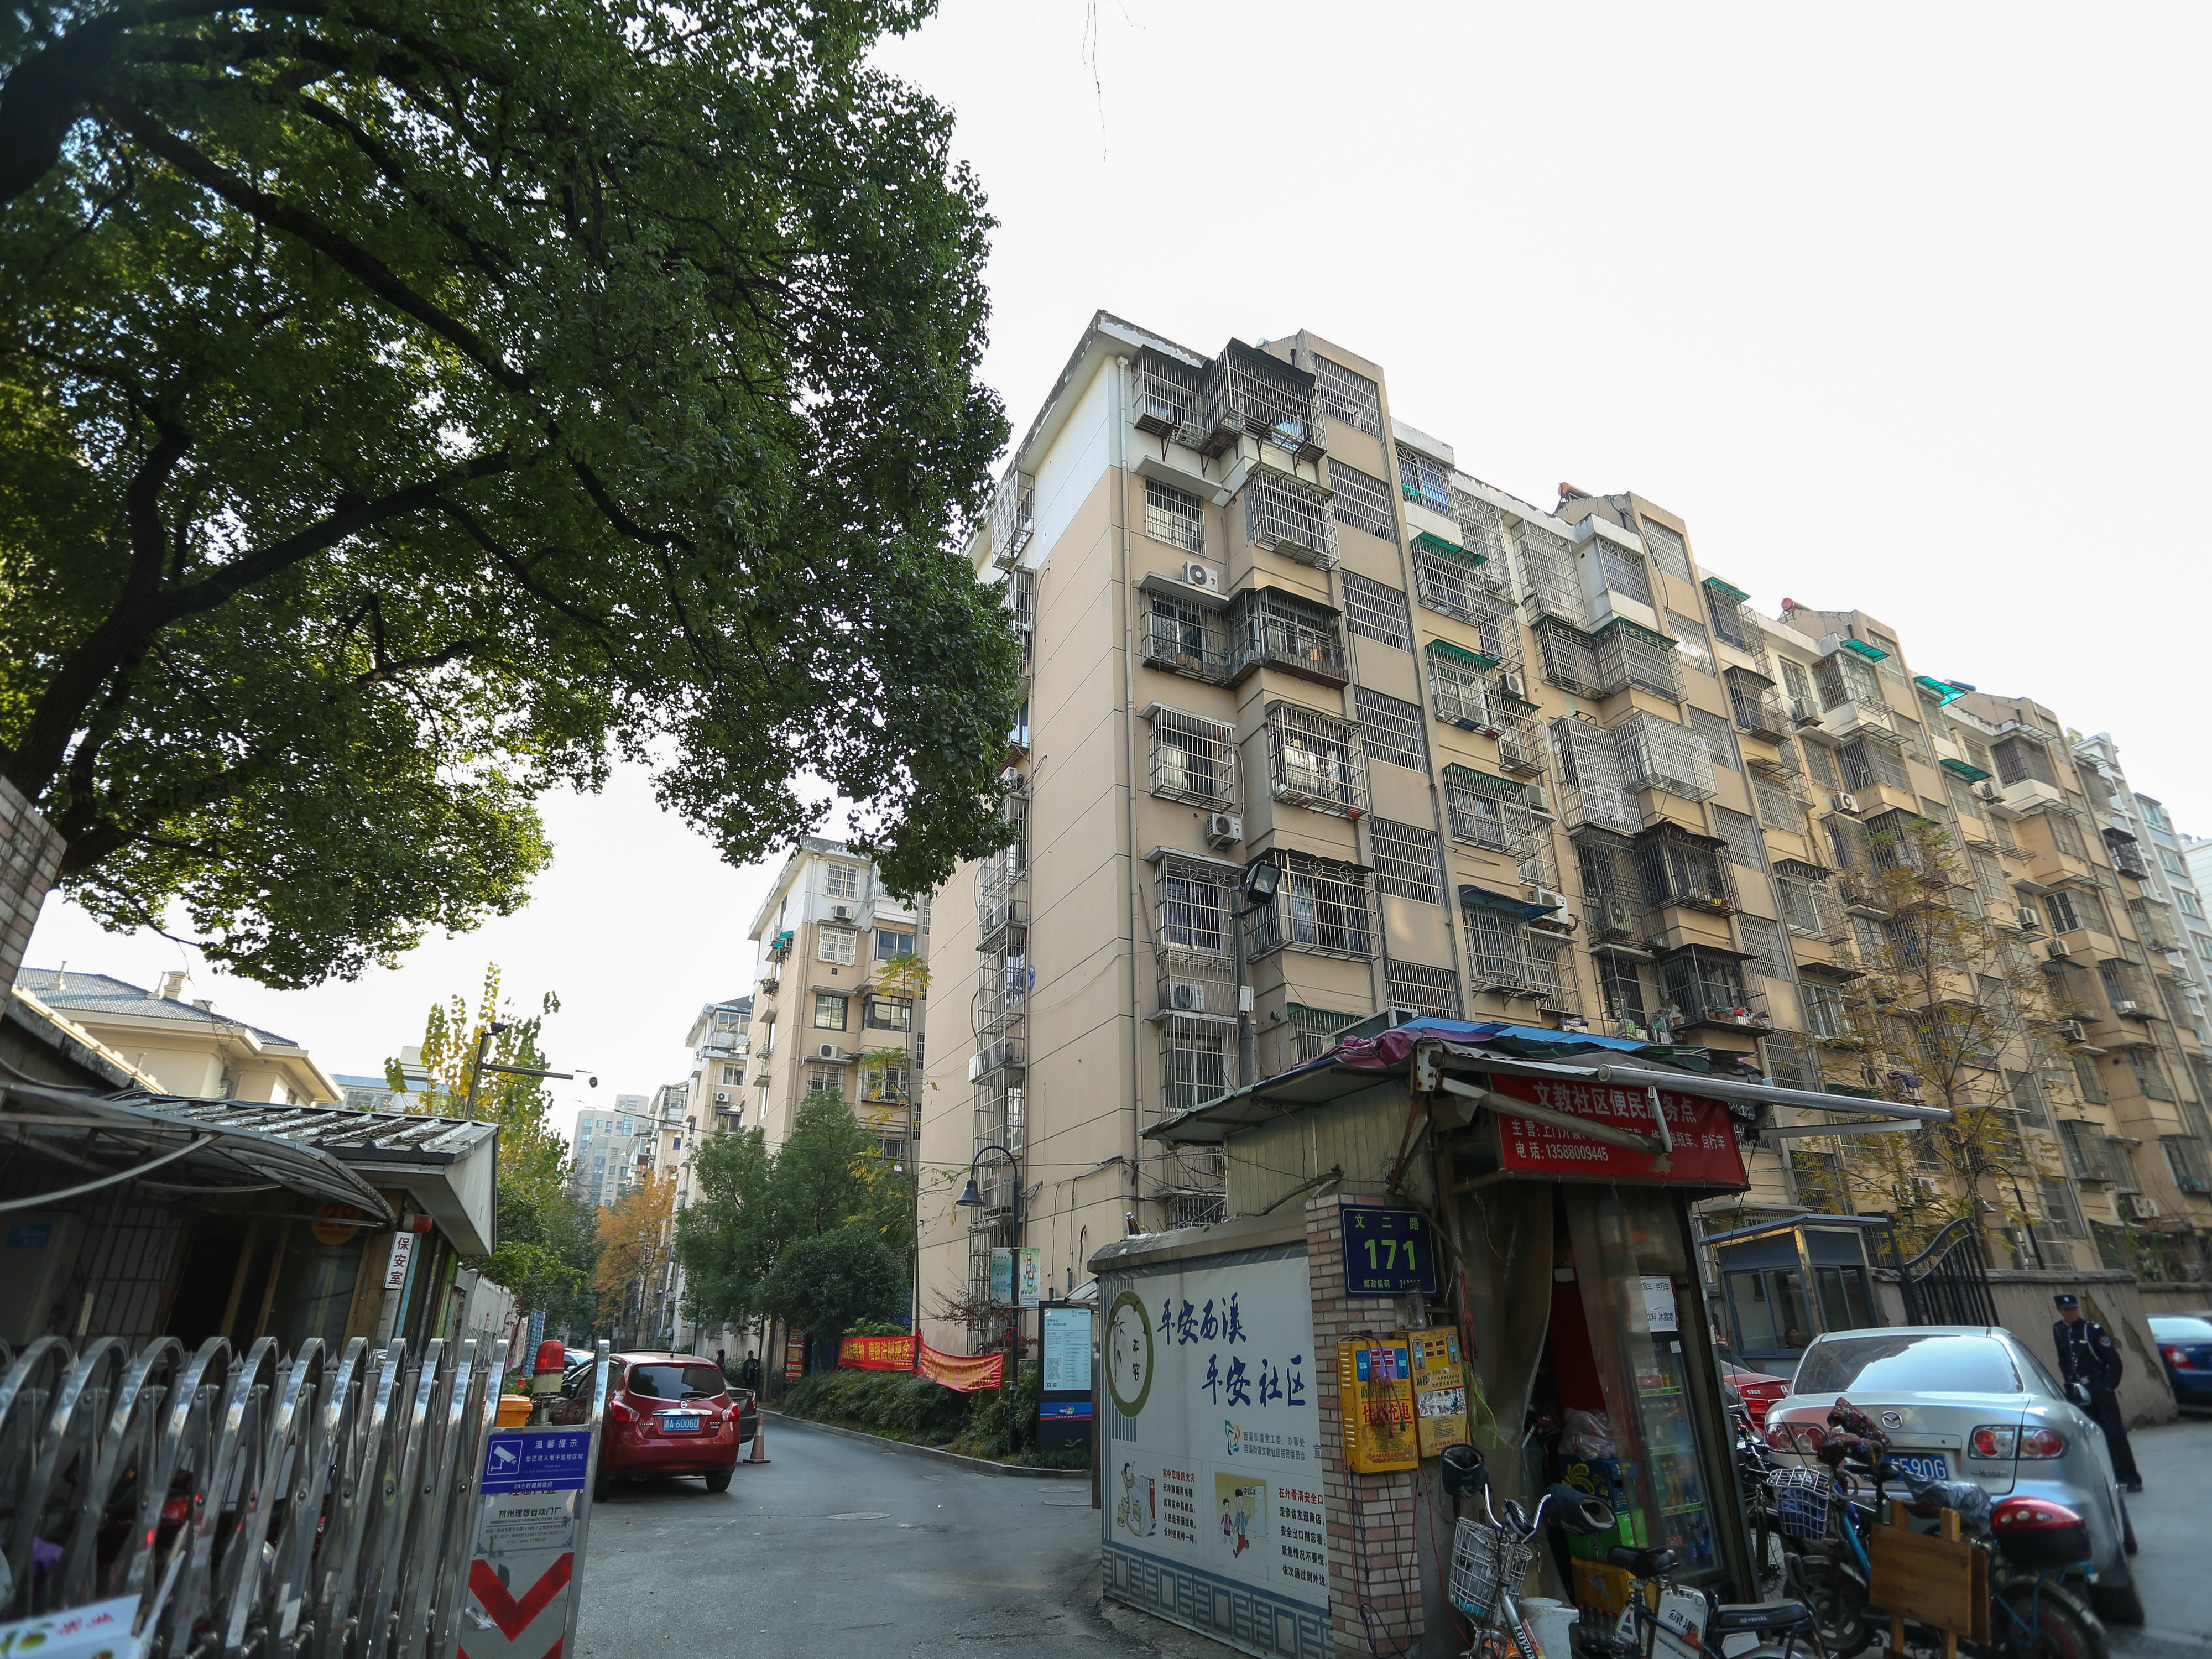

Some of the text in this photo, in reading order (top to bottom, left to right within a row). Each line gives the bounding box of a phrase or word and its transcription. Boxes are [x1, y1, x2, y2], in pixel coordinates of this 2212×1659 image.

[389, 1237, 410, 1285] 保安室
[1364, 1239, 1416, 1270] 171
[1364, 1279, 1390, 1289] 邮政编码
[1157, 1292, 1246, 1345] 平安西溪
[1202, 1354, 1306, 1408] 平安社区
[535, 1439, 578, 1449] 温馨提示
[1244, 1444, 1306, 1461] 西溪街道文教社区居民委员会
[525, 1453, 584, 1462] 您已进入电子监控区域
[1162, 1469, 1195, 1483] 家中取暖防火灾
[1890, 1458, 1947, 1479] 590G
[1279, 1487, 1323, 1505] 在外看清安全口
[499, 1507, 562, 1518] 杭州理想自动门厂
